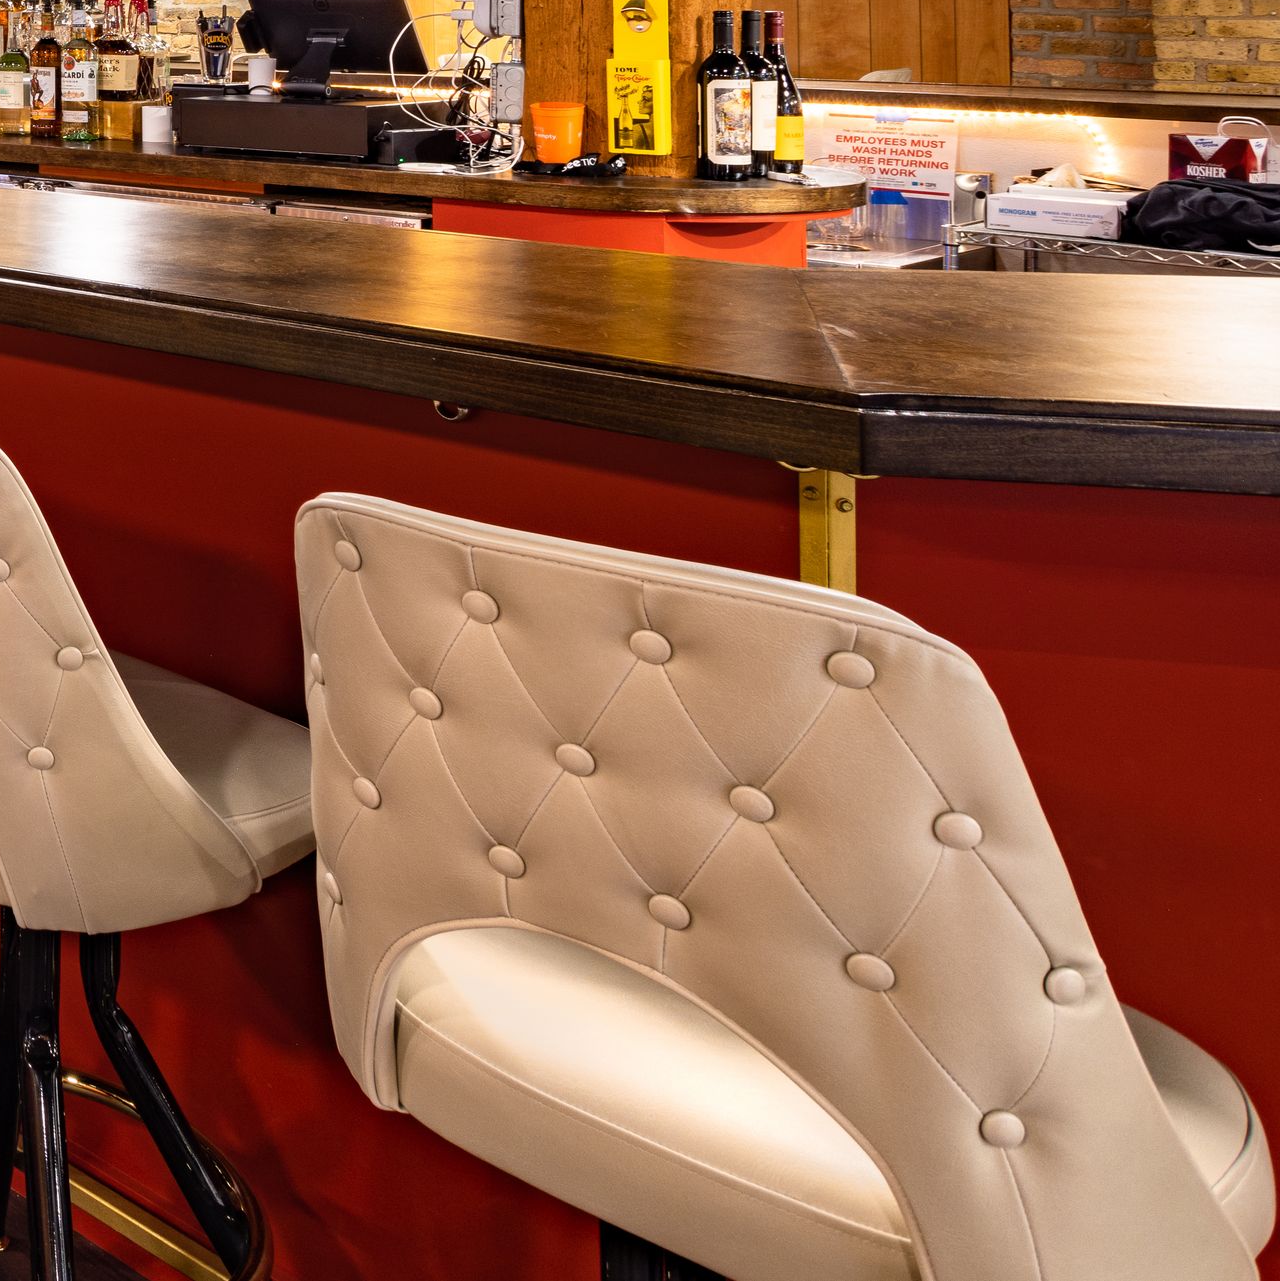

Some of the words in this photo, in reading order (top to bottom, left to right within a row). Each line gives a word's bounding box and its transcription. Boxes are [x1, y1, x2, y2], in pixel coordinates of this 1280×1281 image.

[835, 134, 908, 147] EMPLOYEES
[910, 139, 947, 149] MUST
[851, 145, 887, 156] WASH
[889, 148, 933, 158] HANDS
[827, 154, 875, 165] BEFORE
[877, 158, 950, 170] RETURNING
[859, 166, 876, 175] TO
[878, 167, 917, 178] WORK
[1186, 164, 1227, 179] KOSHER
[998, 207, 1037, 216] MONOGRAM
